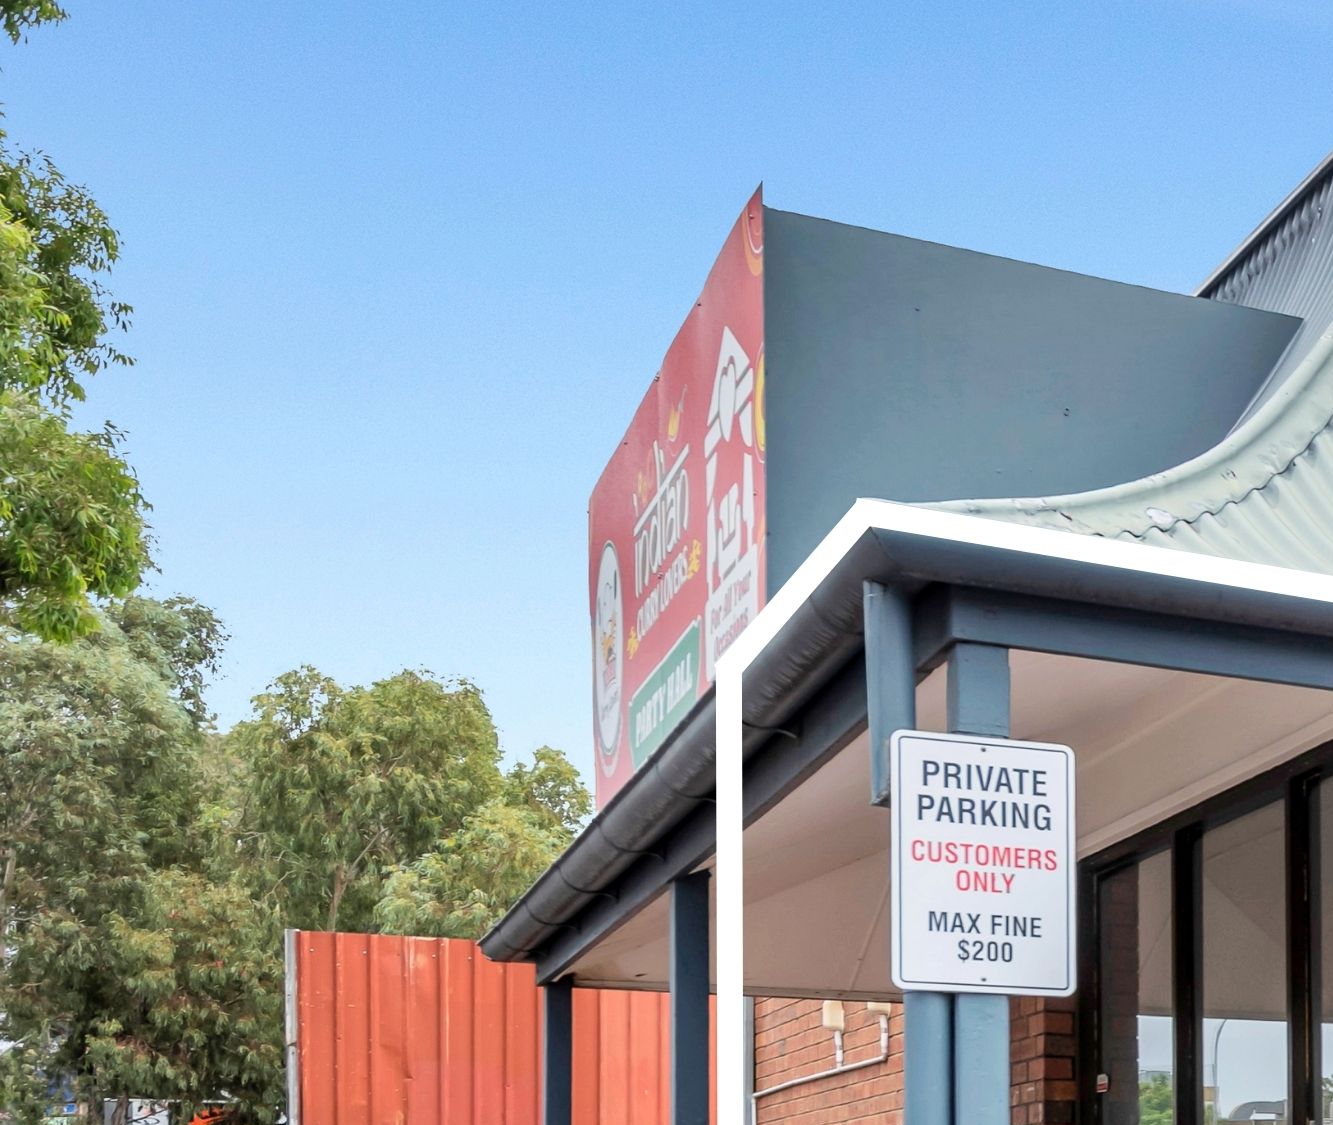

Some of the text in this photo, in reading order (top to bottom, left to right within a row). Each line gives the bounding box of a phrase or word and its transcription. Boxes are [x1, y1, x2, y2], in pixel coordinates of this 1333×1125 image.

[636, 653, 693, 748] PARTY HALL
[922, 760, 1047, 797] PRIVATE
[917, 794, 1052, 831] PARKING
[912, 839, 1057, 871] CUSTOMERS
[956, 869, 1015, 894] ONLY
[928, 911, 1042, 938] MAX FINE
[957, 939, 1013, 963] $200
